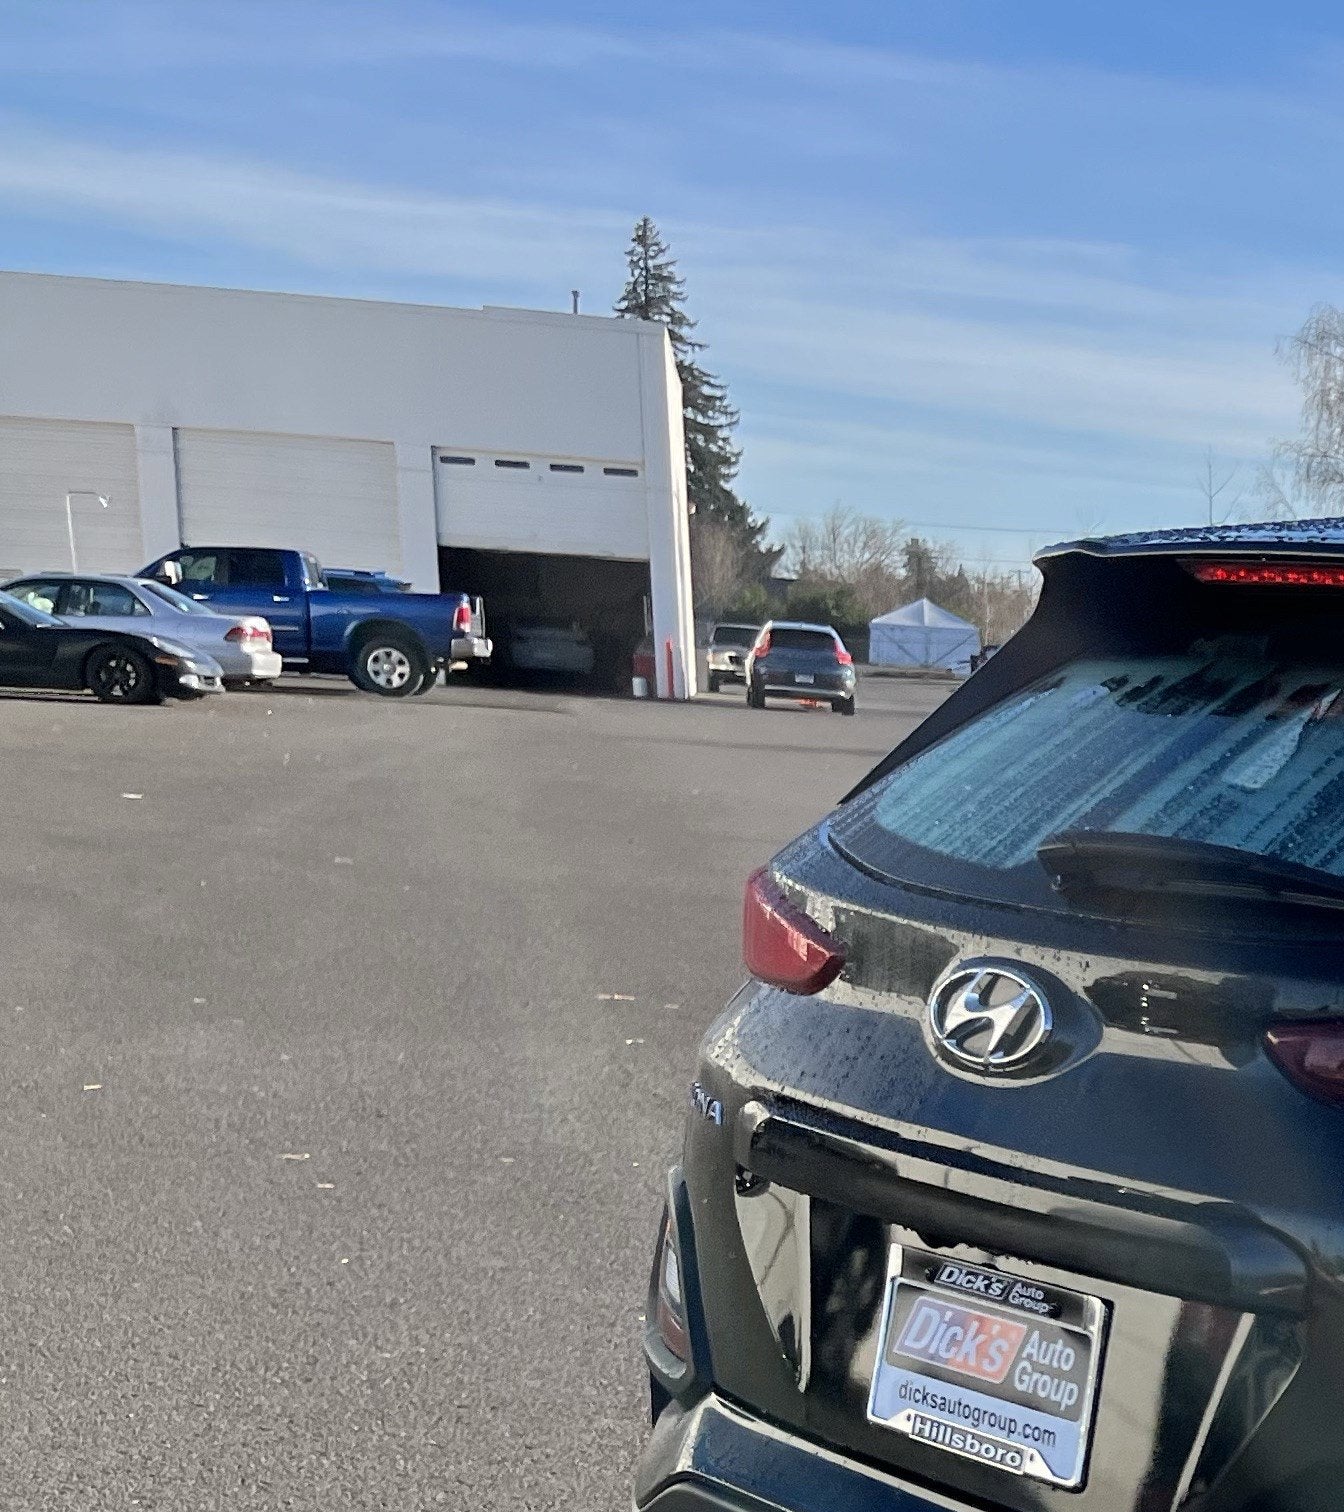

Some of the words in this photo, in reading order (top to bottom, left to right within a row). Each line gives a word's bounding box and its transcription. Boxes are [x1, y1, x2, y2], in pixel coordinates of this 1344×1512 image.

[1008, 1292, 1050, 1314] Group
[1011, 1282, 1045, 1301] Auto
[903, 1306, 1011, 1373] Dick's
[1021, 1330, 1076, 1371] Auto
[1014, 1361, 1079, 1410] Group
[898, 1379, 1057, 1447] dicksautogroup.com
[913, 1414, 1023, 1468] Hillsboro
